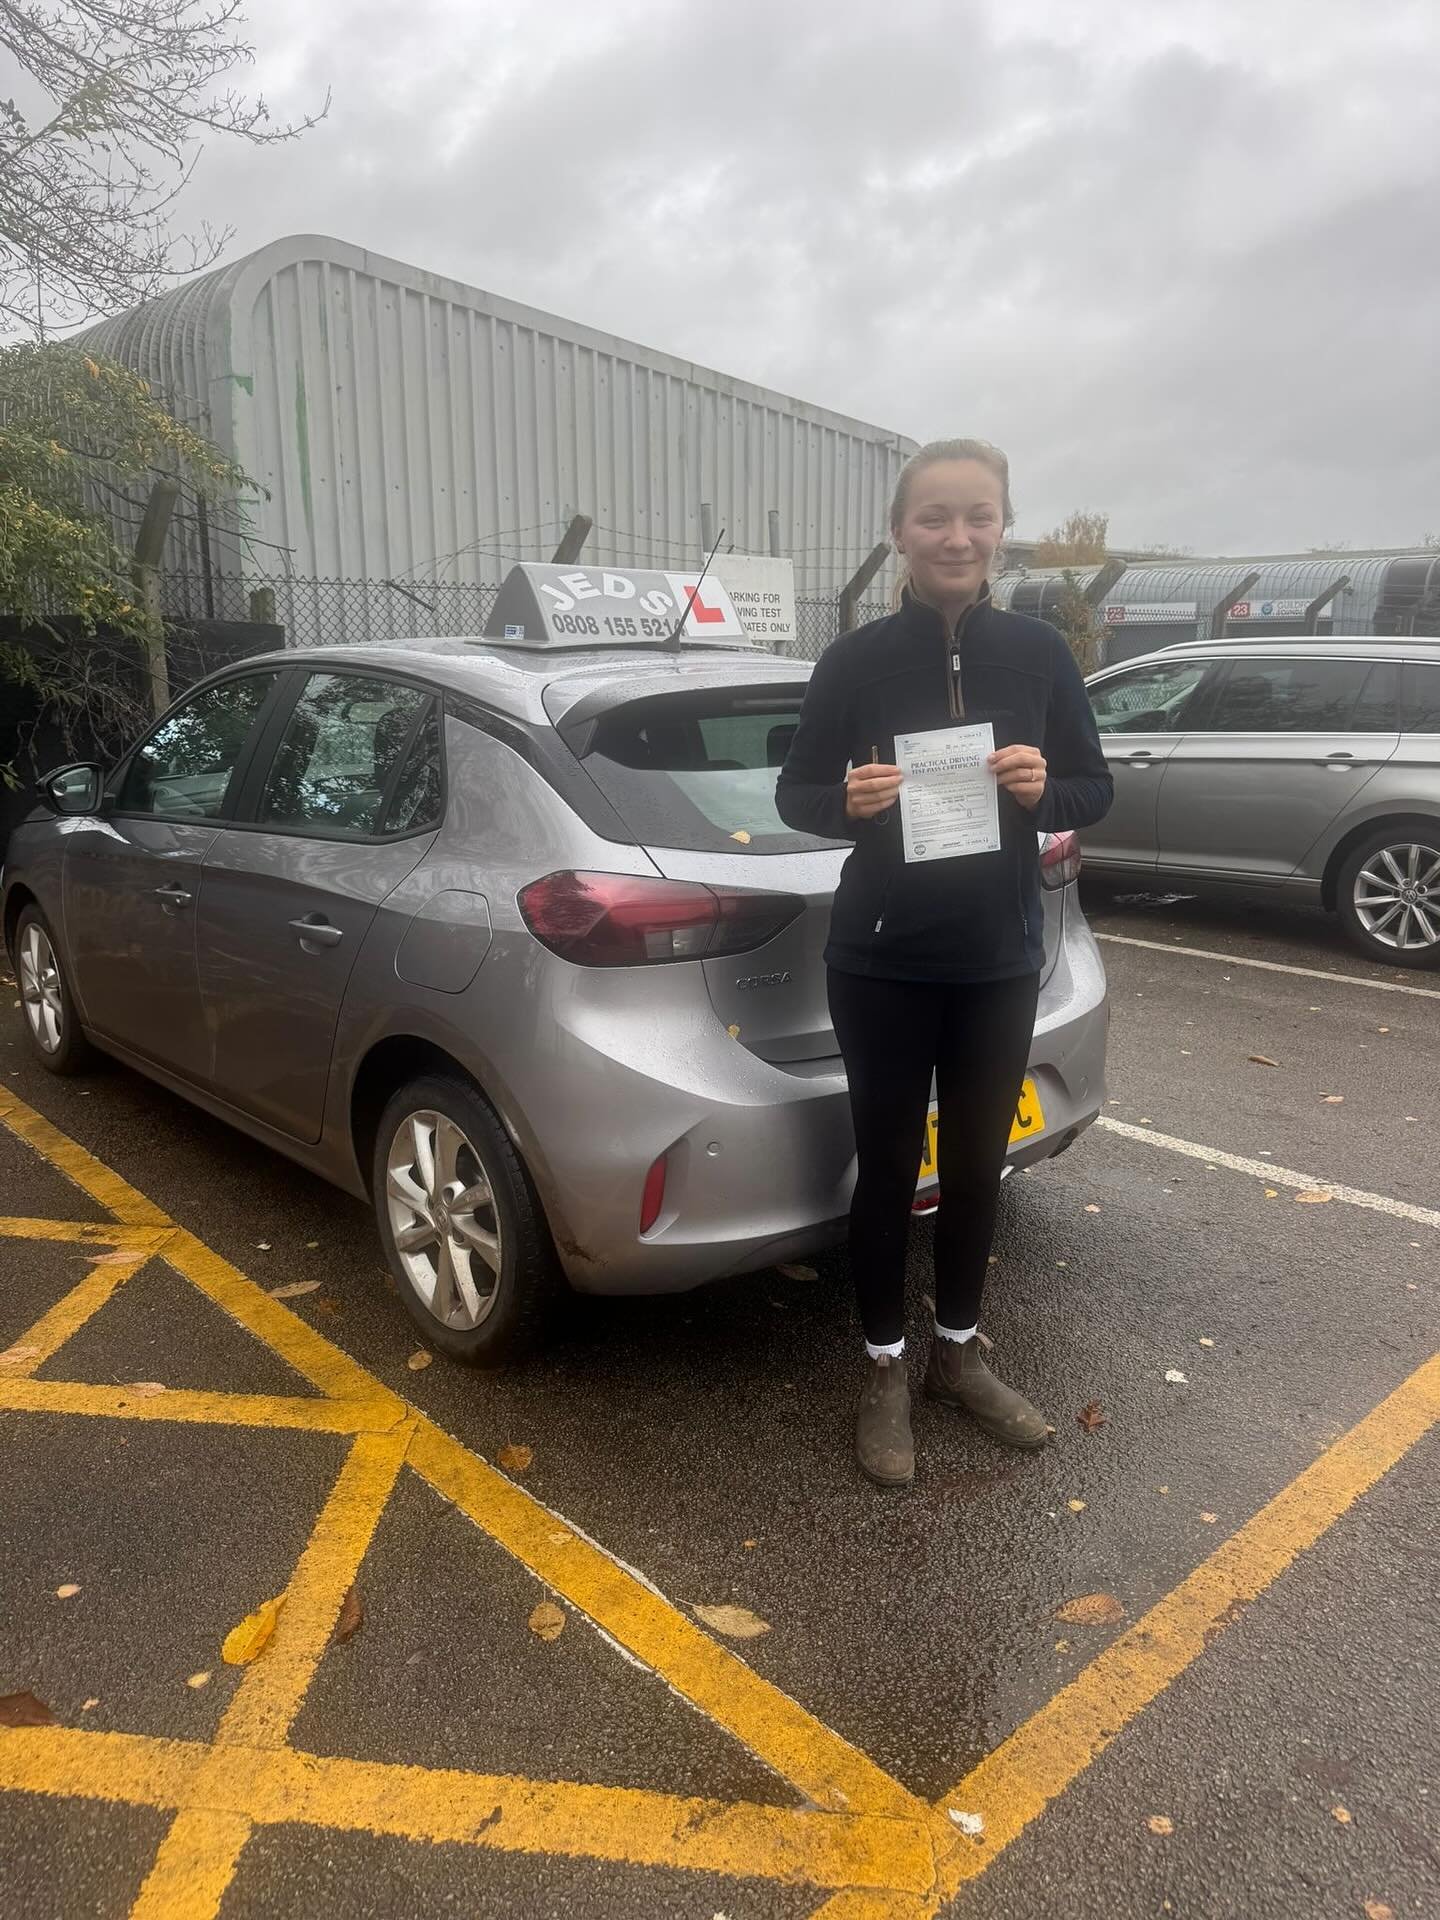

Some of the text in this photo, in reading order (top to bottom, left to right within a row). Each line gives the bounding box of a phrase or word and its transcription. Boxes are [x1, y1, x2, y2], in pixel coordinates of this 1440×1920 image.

[540, 572, 674, 616] JEDS
[729, 591, 781, 604] ARKING FOR
[683, 585, 726, 623] L
[1232, 604, 1249, 616] 23
[737, 607, 782, 618] VING TEST
[552, 613, 600, 635] 0808
[604, 616, 638, 636] 155
[743, 622, 791, 633] ATES ONLY
[911, 755, 980, 769] PRACTICAL DRIVING
[927, 766, 942, 774] PASS
[943, 762, 980, 771] CERTIFICATE
